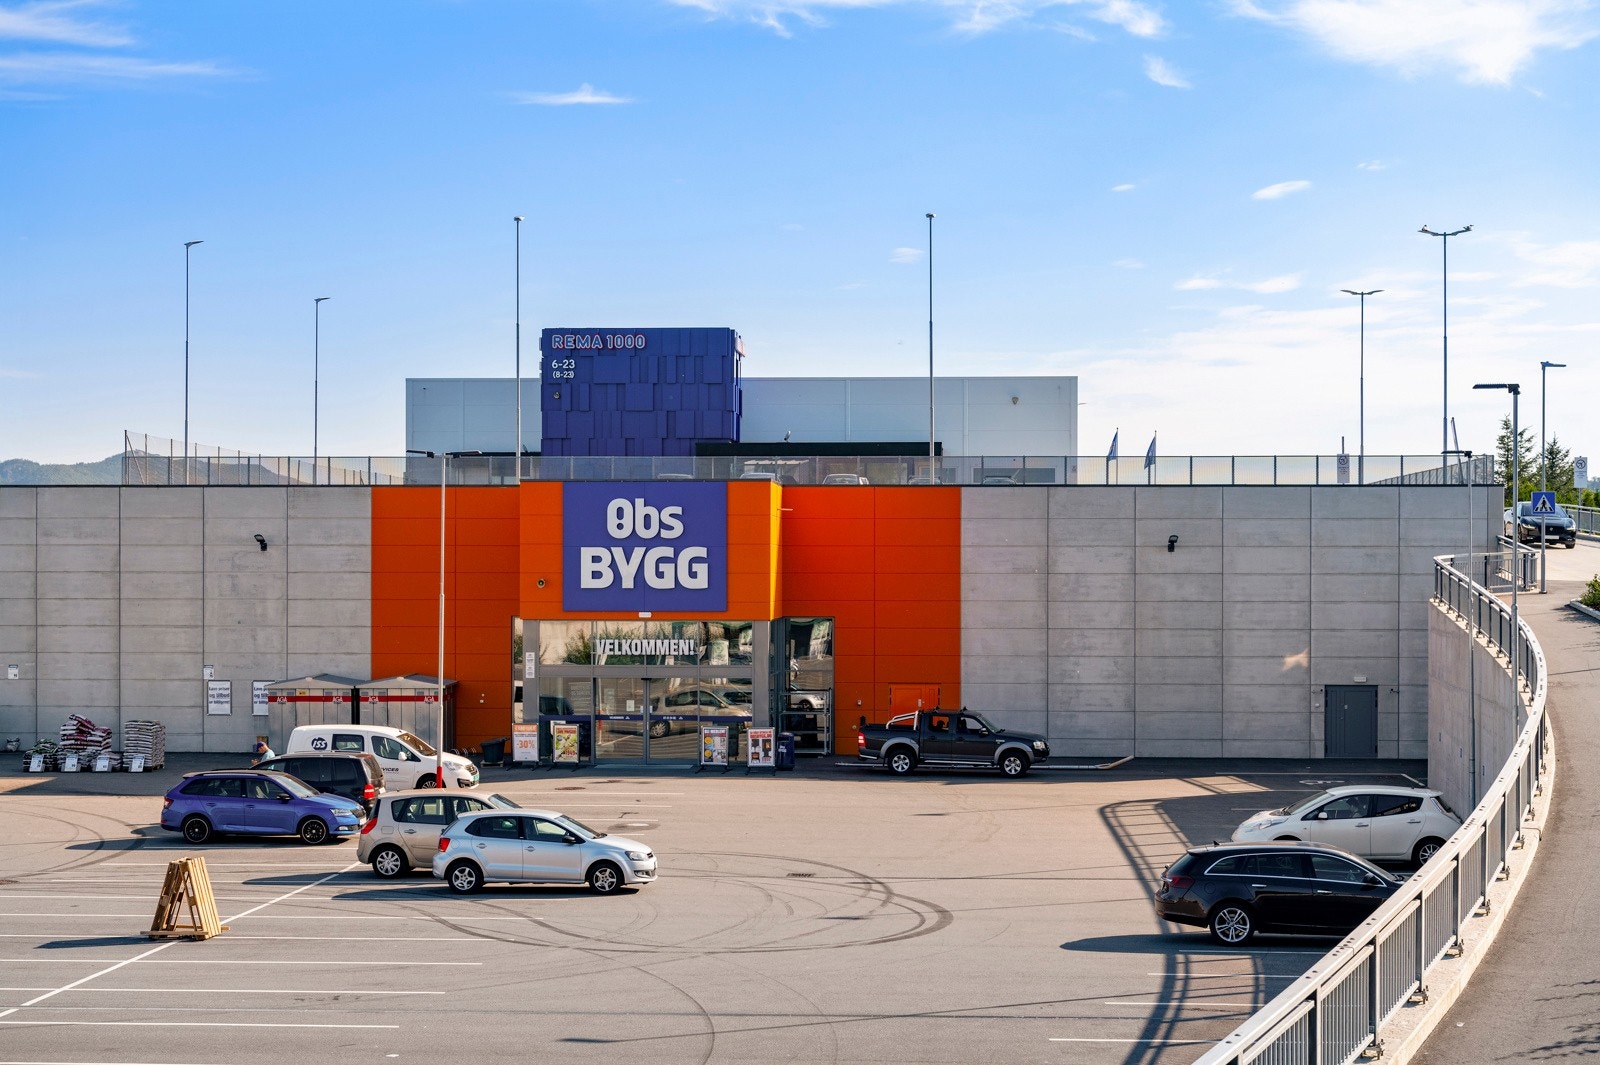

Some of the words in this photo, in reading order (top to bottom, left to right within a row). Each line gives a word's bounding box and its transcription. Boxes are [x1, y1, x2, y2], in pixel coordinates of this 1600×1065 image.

[552, 334, 603, 349] REMA
[606, 334, 645, 349] 1000
[551, 359, 575, 369] 6-23
[552, 370, 575, 379] (8-23)
[580, 546, 709, 590] BYGG
[596, 639, 695, 656] VELKOMMEN!
